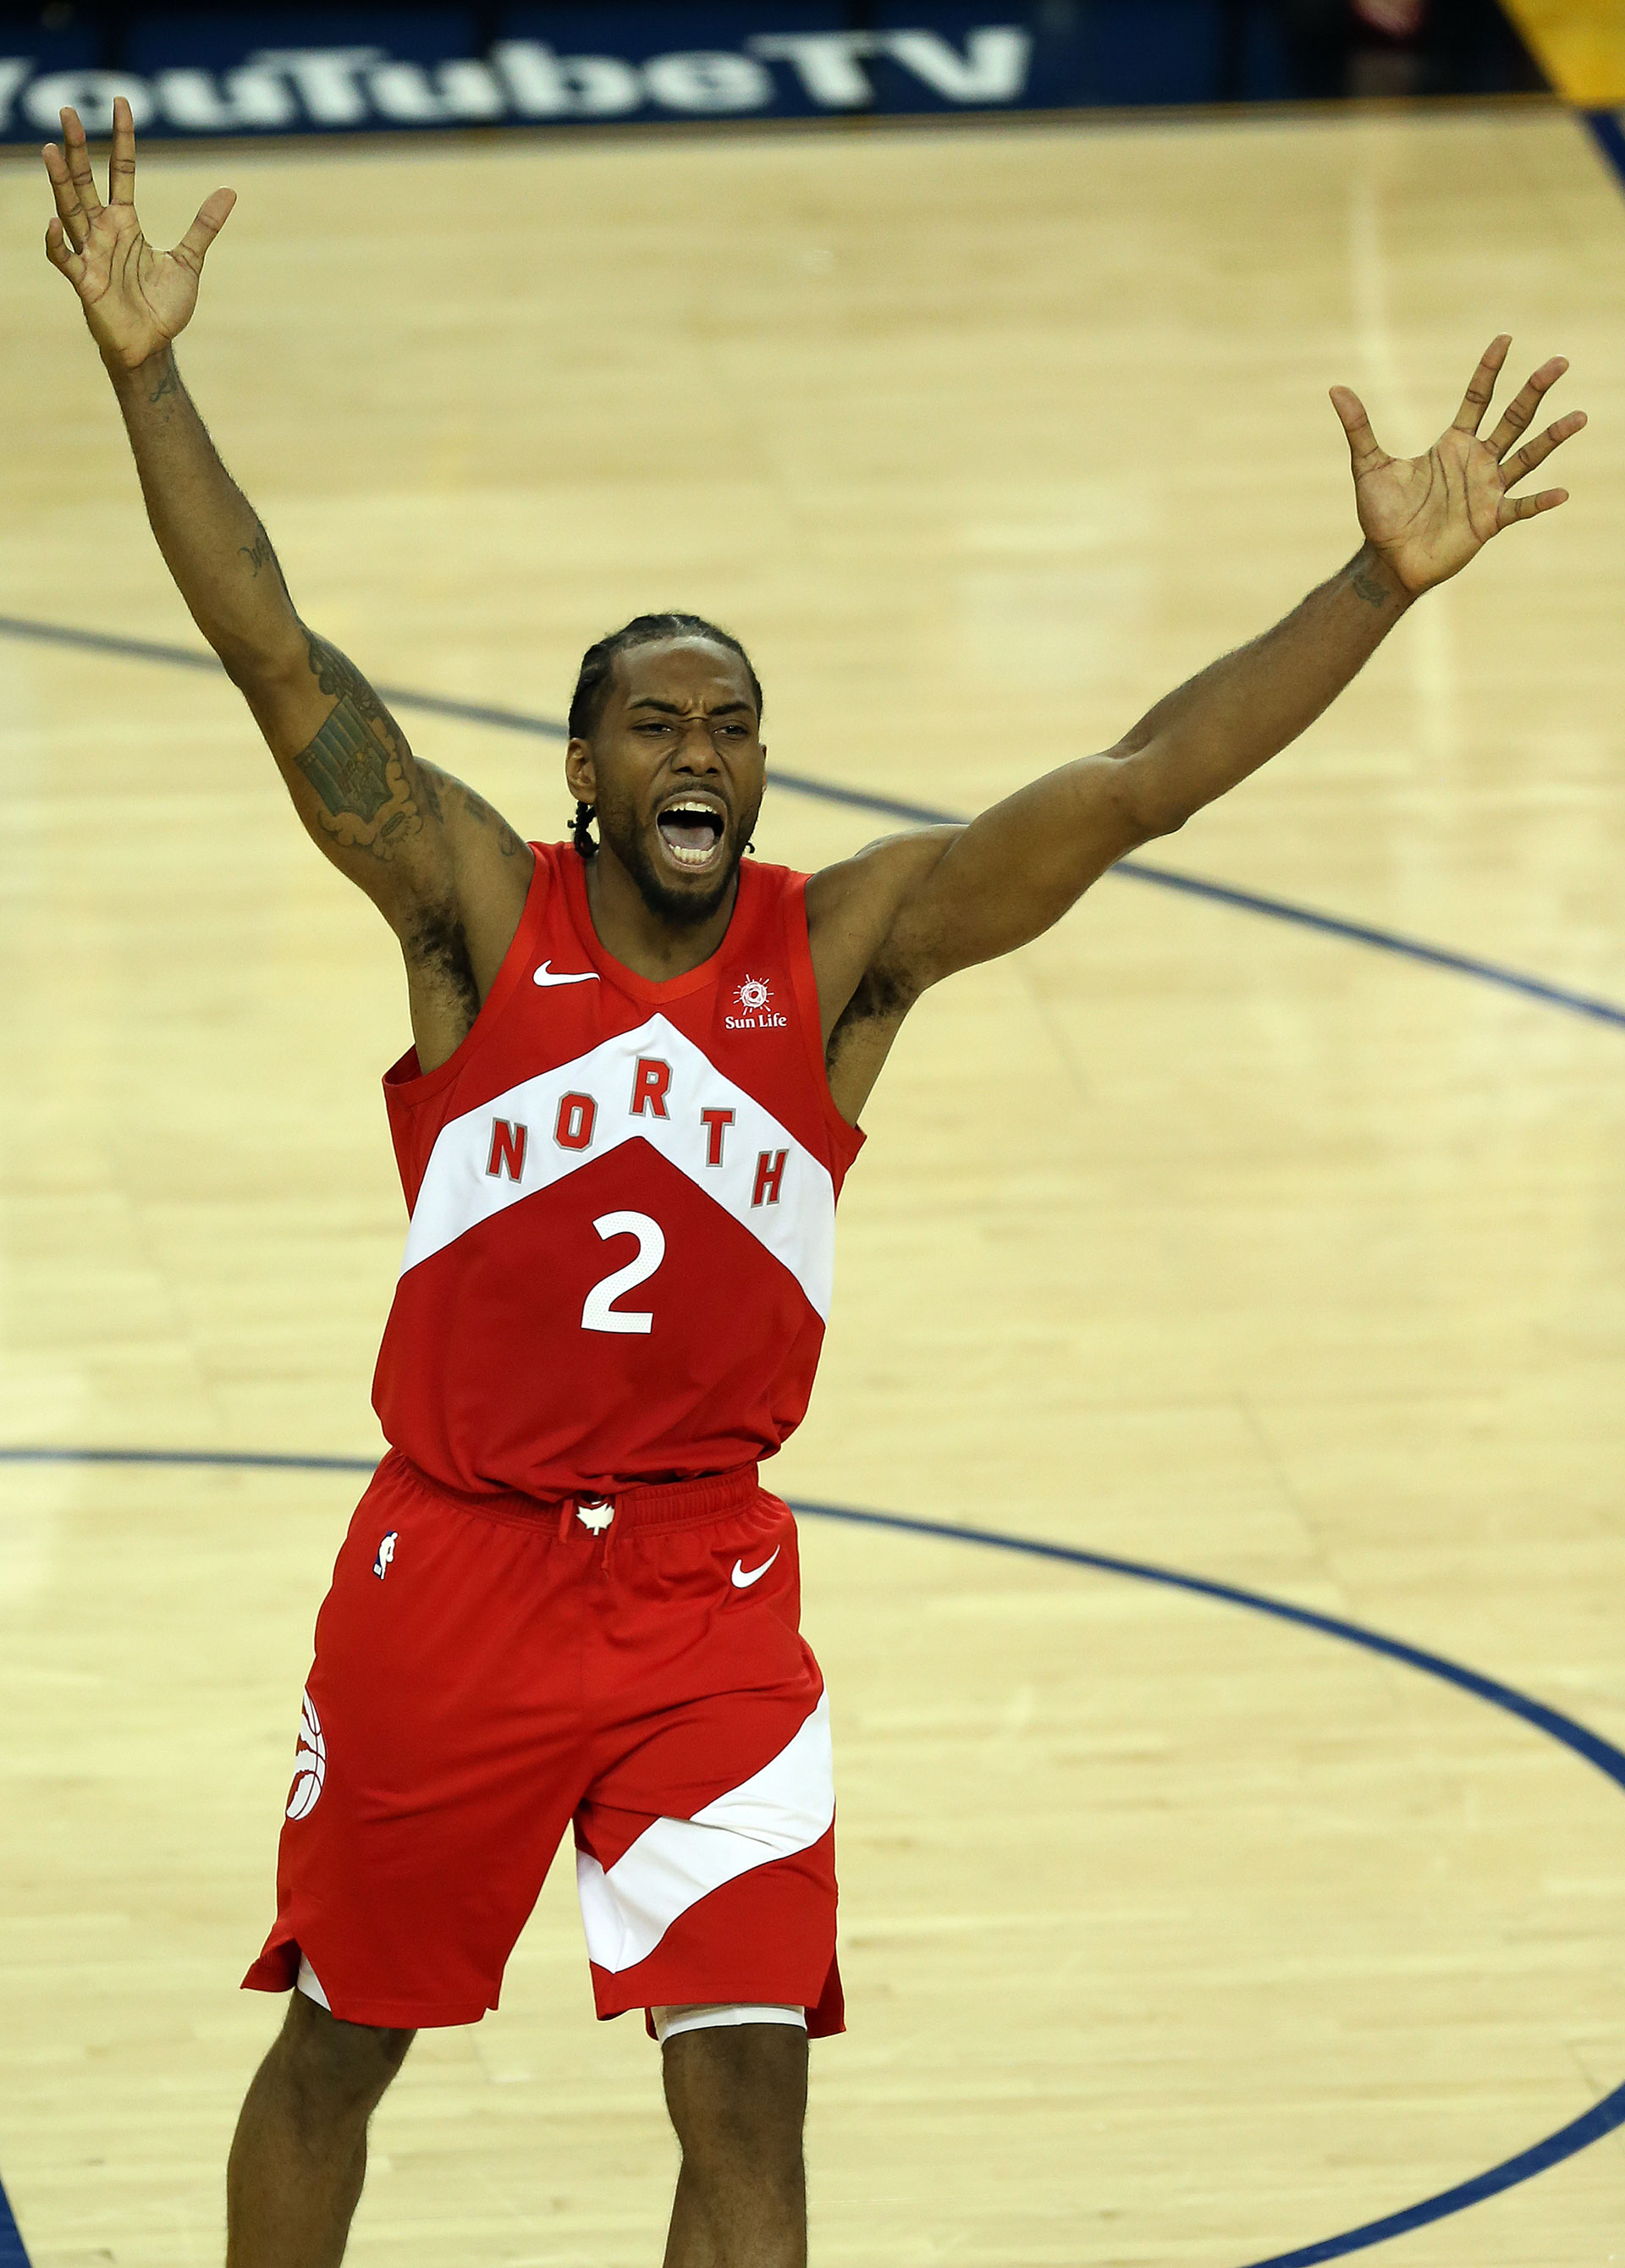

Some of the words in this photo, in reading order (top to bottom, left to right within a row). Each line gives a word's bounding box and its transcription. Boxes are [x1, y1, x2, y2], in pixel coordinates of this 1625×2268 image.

[725, 1016, 756, 1029] Sun
[758, 1013, 787, 1027] Life
[485, 1054, 790, 1208] NORTH
[581, 1210, 666, 1335] 2
